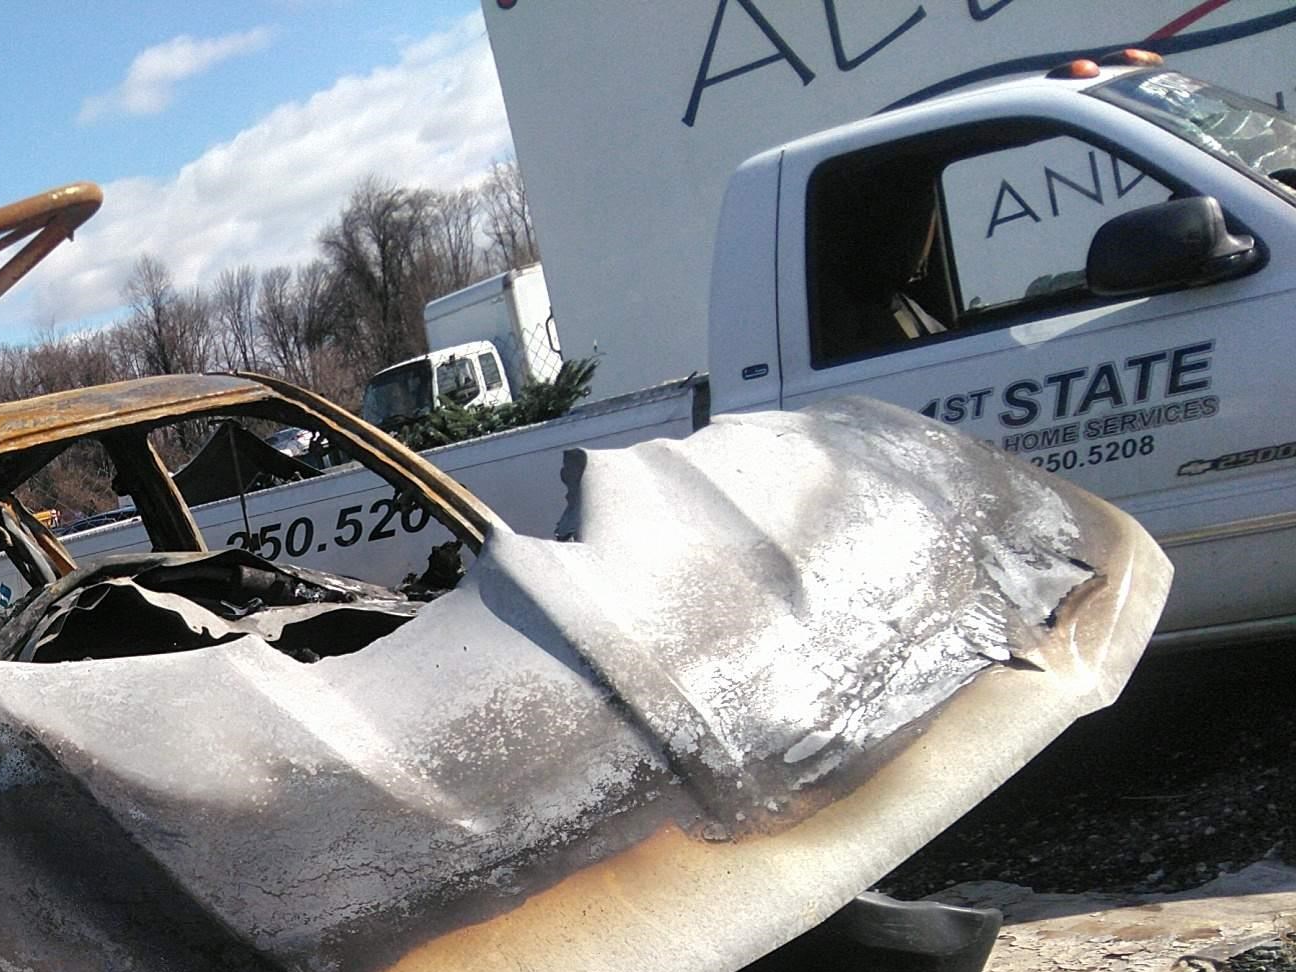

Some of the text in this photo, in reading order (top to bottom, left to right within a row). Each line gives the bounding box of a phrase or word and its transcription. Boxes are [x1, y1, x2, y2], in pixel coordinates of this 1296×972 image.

[680, 0, 1016, 128] AL
[999, 338, 1217, 428] STATE
[1004, 395, 1220, 454] HOME SERVICES
